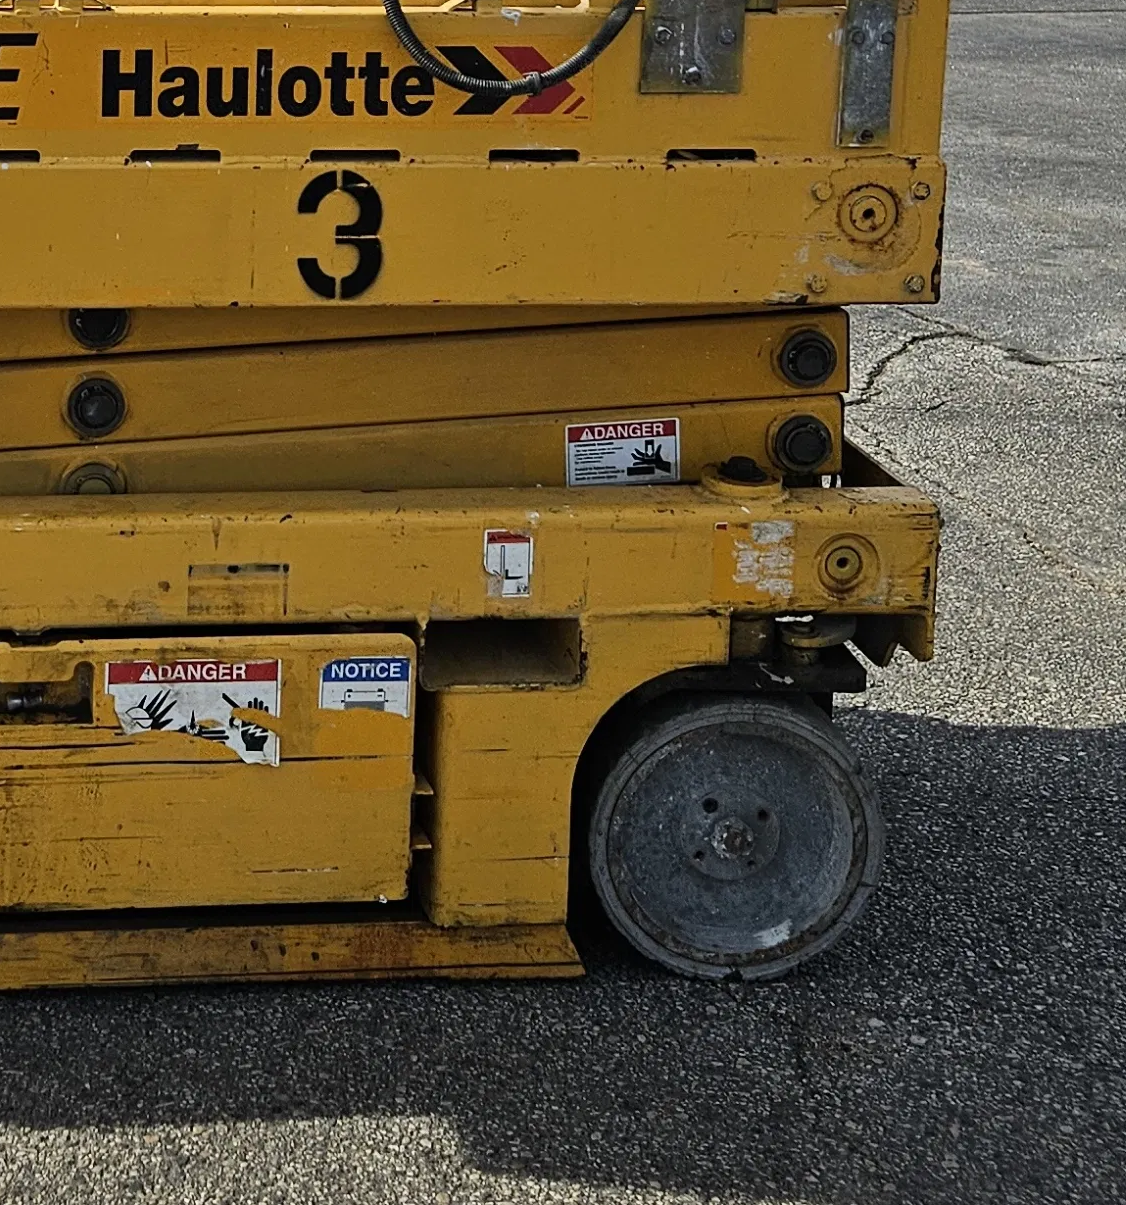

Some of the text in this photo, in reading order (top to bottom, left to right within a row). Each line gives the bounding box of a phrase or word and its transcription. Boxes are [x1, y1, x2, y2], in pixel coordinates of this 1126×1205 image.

[101, 48, 435, 118] Haulotte
[297, 169, 382, 300] 3
[594, 422, 664, 440] DANGER
[158, 663, 247, 681] DANGER
[331, 662, 402, 679] NOTICE
